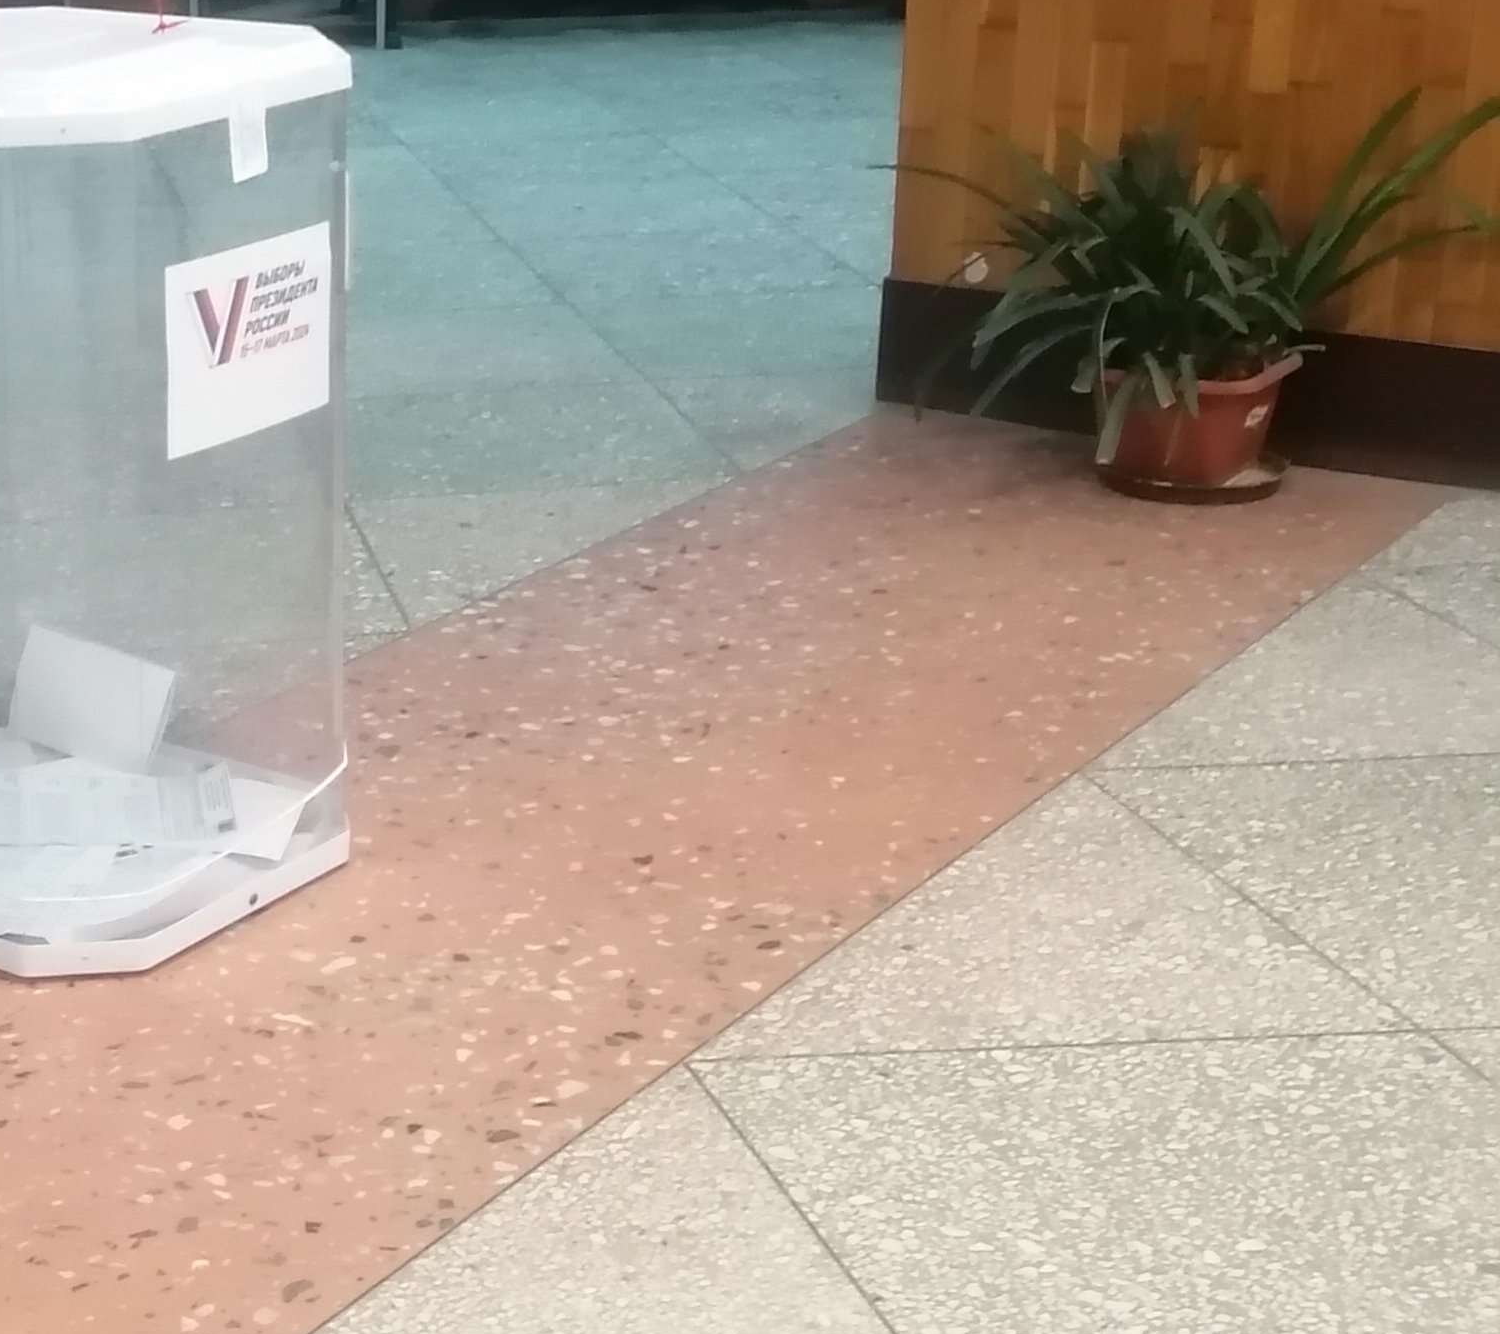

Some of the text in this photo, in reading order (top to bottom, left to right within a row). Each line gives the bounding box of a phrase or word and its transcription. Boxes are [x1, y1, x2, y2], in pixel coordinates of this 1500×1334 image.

[255, 260, 305, 289] ВЫБОРЫ
[250, 277, 318, 313] ПРЕЗИДЕНТА
[244, 309, 291, 338] РОССИИ
[263, 331, 291, 351] МАРТА
